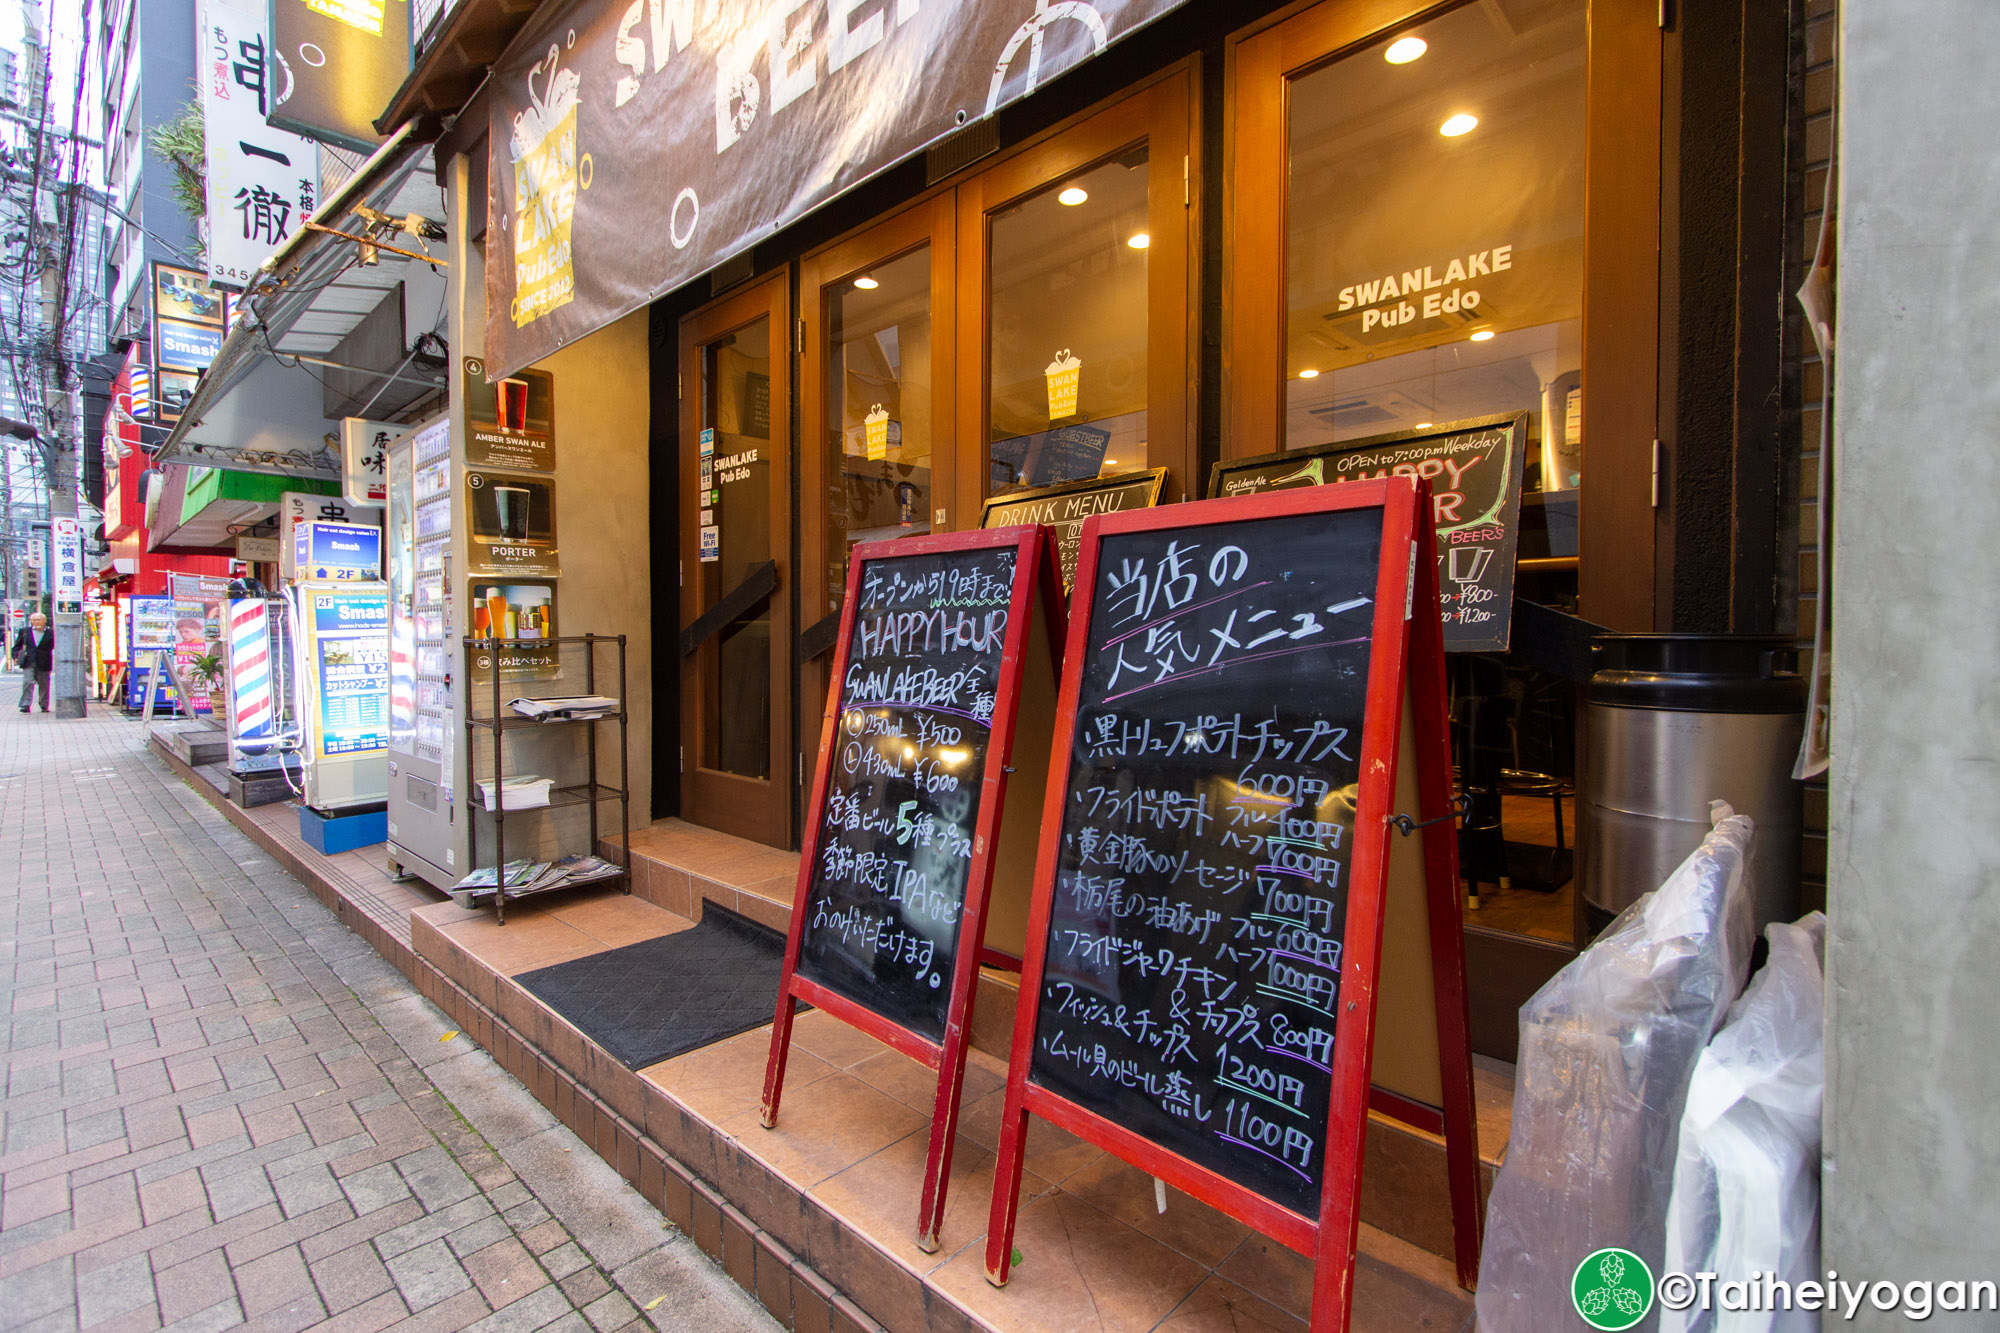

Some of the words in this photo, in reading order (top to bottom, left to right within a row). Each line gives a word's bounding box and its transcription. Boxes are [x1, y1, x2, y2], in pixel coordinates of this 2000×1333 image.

[213, 26, 231, 101] もつ煮込
[518, 129, 573, 212] SWAN
[516, 179, 574, 252] LAKE
[519, 291, 547, 317] SINCE
[547, 275, 571, 304] 2012
[1338, 244, 1512, 311] SWANLAKE
[1362, 301, 1416, 333] Pub
[1423, 287, 1480, 319] Edo
[164, 337, 220, 357] Smash
[470, 363, 477, 371] 4
[1048, 372, 1078, 389] SWAN
[1049, 384, 1078, 401] LAKE
[475, 433, 504, 444] AMBER
[505, 437, 530, 447] SWAN
[530, 440, 546, 449] ALE
[866, 423, 886, 436] SWAN
[866, 433, 886, 445] LAKE
[714, 449, 758, 472] SWANLAKE
[1337, 454, 1378, 472] OPEN
[1380, 455, 1394, 464] to
[1443, 431, 1501, 460] Weekday
[472, 477, 479, 486] 5
[720, 470, 735, 484] Pub
[735, 466, 751, 481] Edo
[1000, 501, 1058, 528] DRINK
[1064, 492, 1124, 519] MENU
[331, 540, 360, 551] Smash
[492, 546, 536, 557] PORTER
[703, 532, 716, 541] Free
[1451, 526, 1504, 545] BEER'S
[200, 581, 229, 592] Smash
[336, 569, 355, 579] 2F
[1106, 540, 1249, 630] 当店の
[318, 597, 332, 607] 2F
[861, 609, 940, 660] HAPPY
[940, 609, 1008, 655] HOUR
[1107, 597, 1373, 690] 人気メニュー
[916, 715, 962, 751] ¥500
[913, 757, 959, 794] ¥600
[1237, 764, 1329, 808] 600円
[1087, 786, 1213, 836] フライドポテト
[1226, 806, 1267, 827] フル
[1079, 826, 1250, 895] 黄金豚のソーセージ
[1221, 831, 1264, 855] ハーフ
[1267, 842, 1341, 888] 700円
[1257, 876, 1335, 934] 700円
[1215, 943, 1266, 971] ハーフ
[1231, 917, 1273, 940] フル
[1276, 923, 1342, 969] 600円
[1196, 1000, 1265, 1049] チップス
[1270, 1013, 1335, 1064] 800円
[1050, 1030, 1212, 1122] ムール貝のビール蒸し
[1216, 1042, 1305, 1108] 1200円
[1225, 1099, 1313, 1168] 1100円
